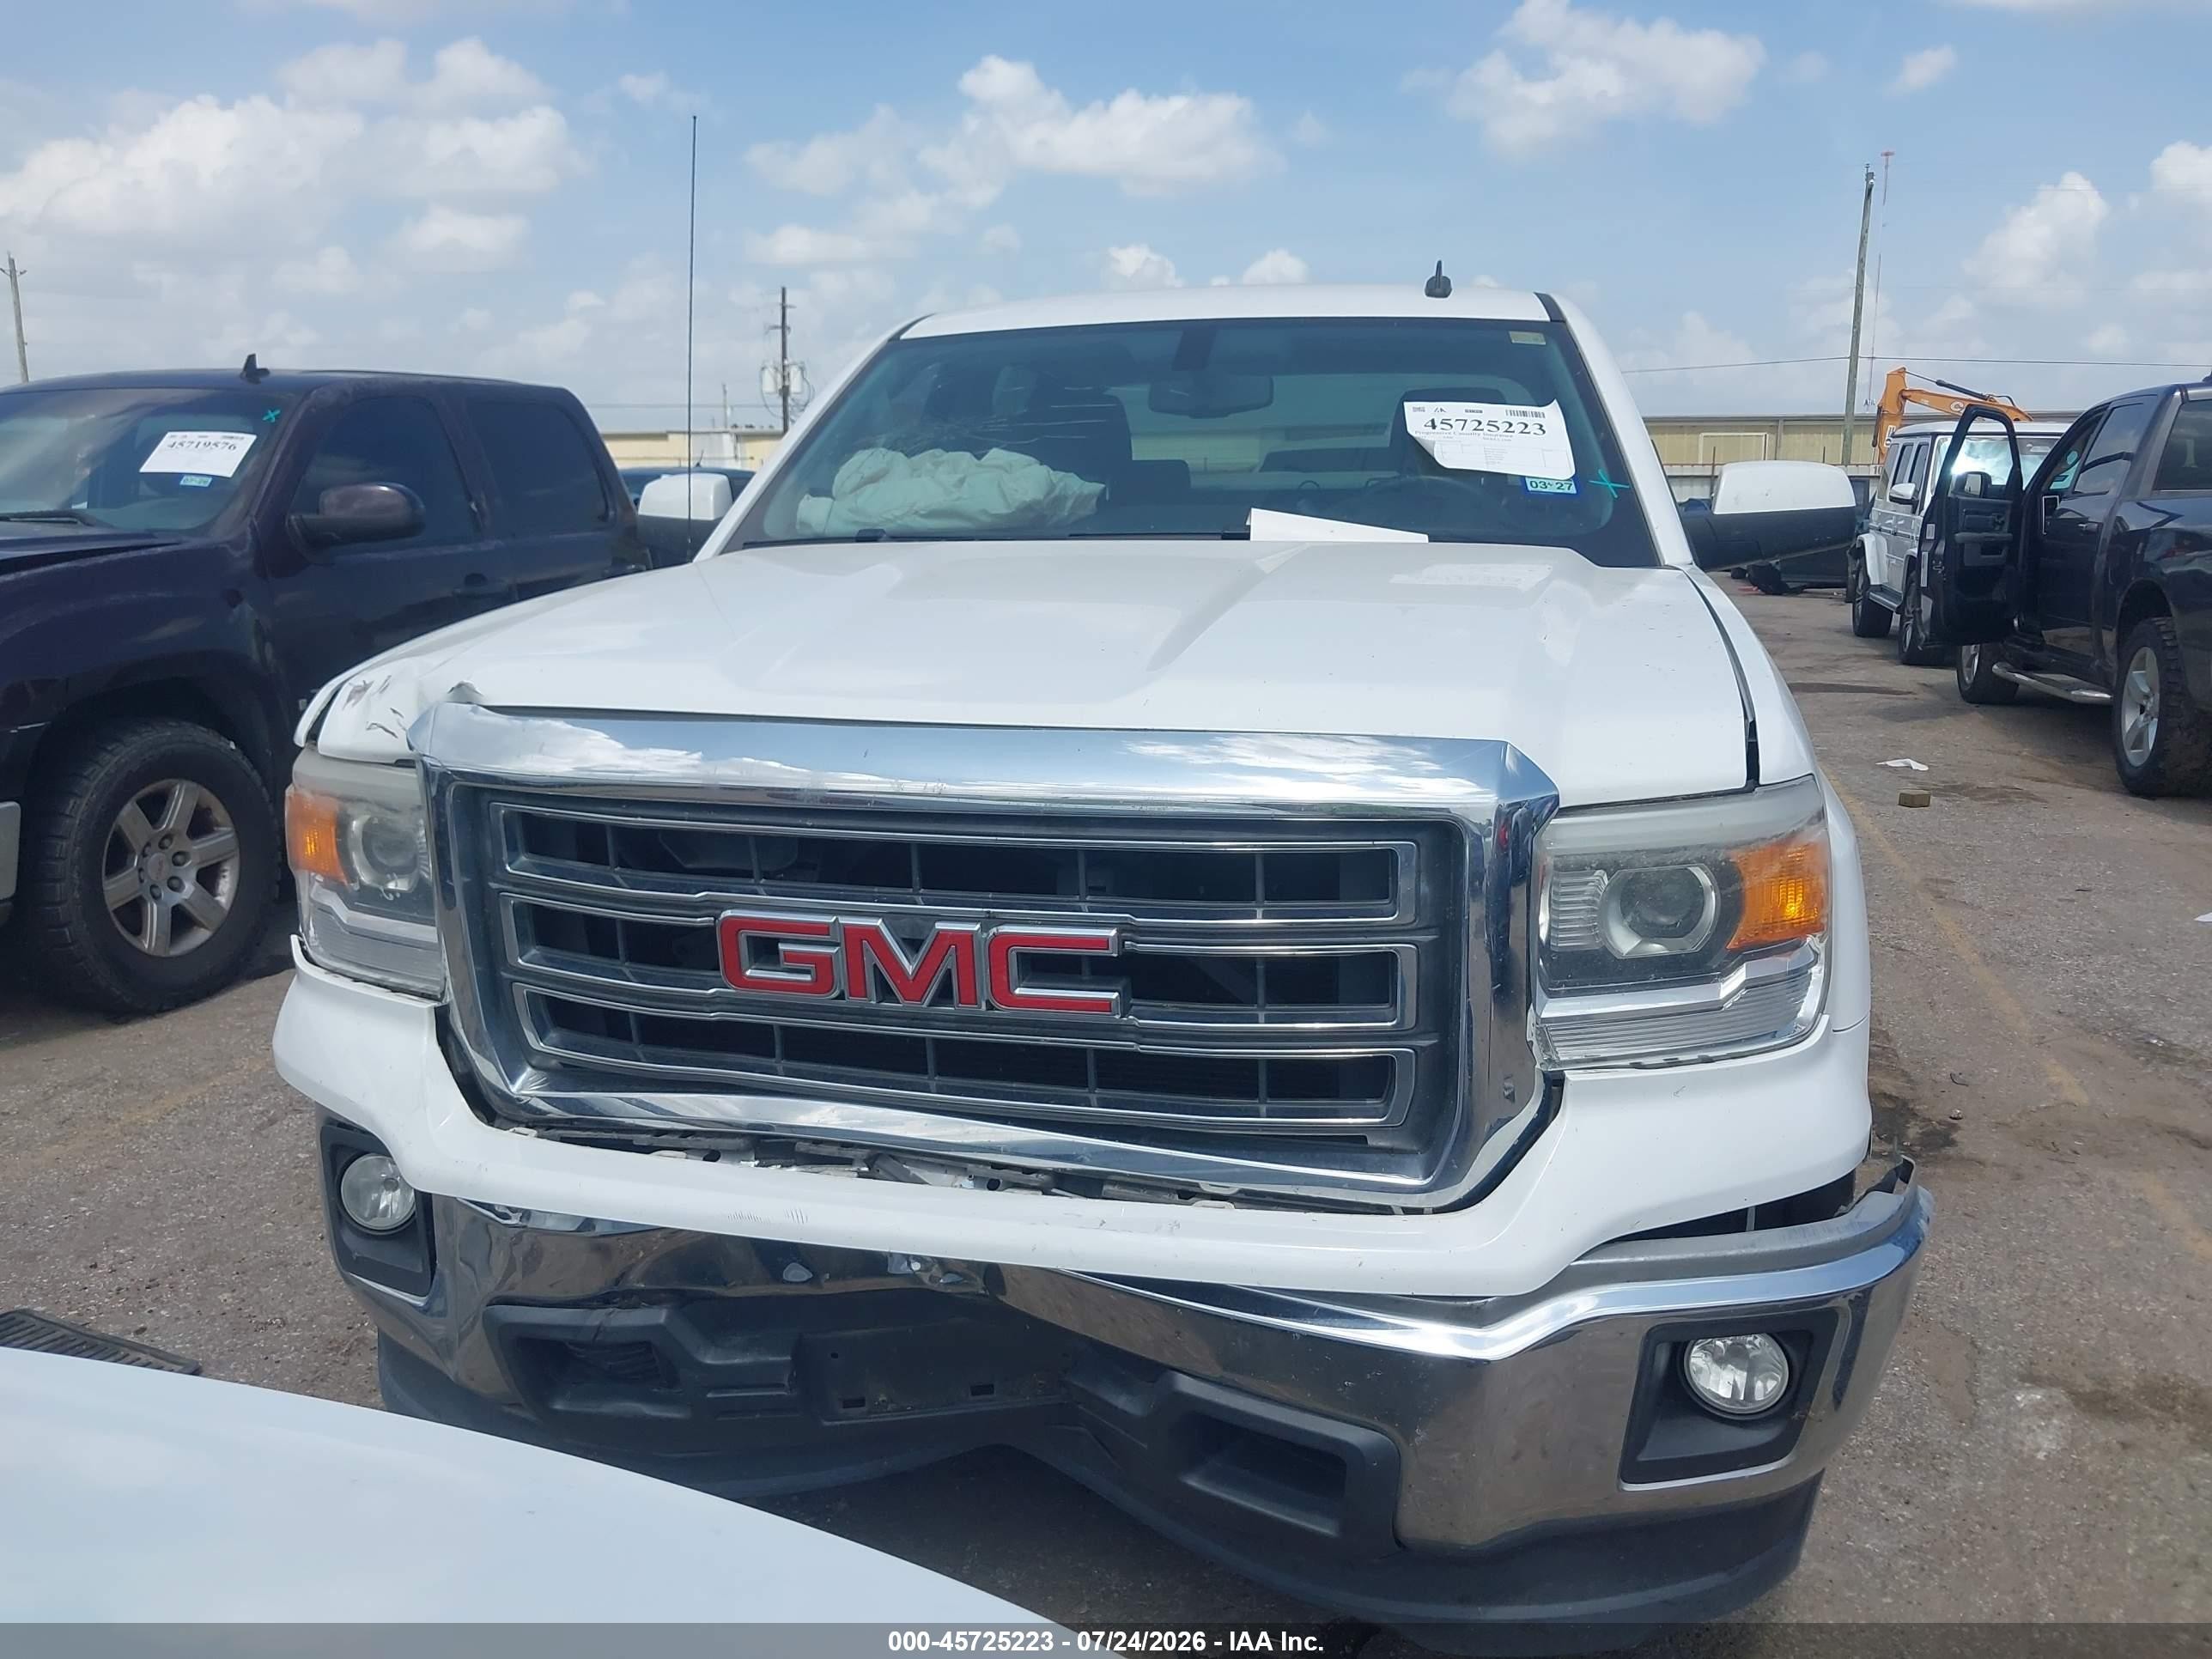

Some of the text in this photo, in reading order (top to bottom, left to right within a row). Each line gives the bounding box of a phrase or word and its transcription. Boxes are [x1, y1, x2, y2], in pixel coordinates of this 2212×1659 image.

[1424, 417, 1546, 436] 45725223
[1529, 480, 1573, 491] 03 27
[717, 908, 1121, 1018] GMC
